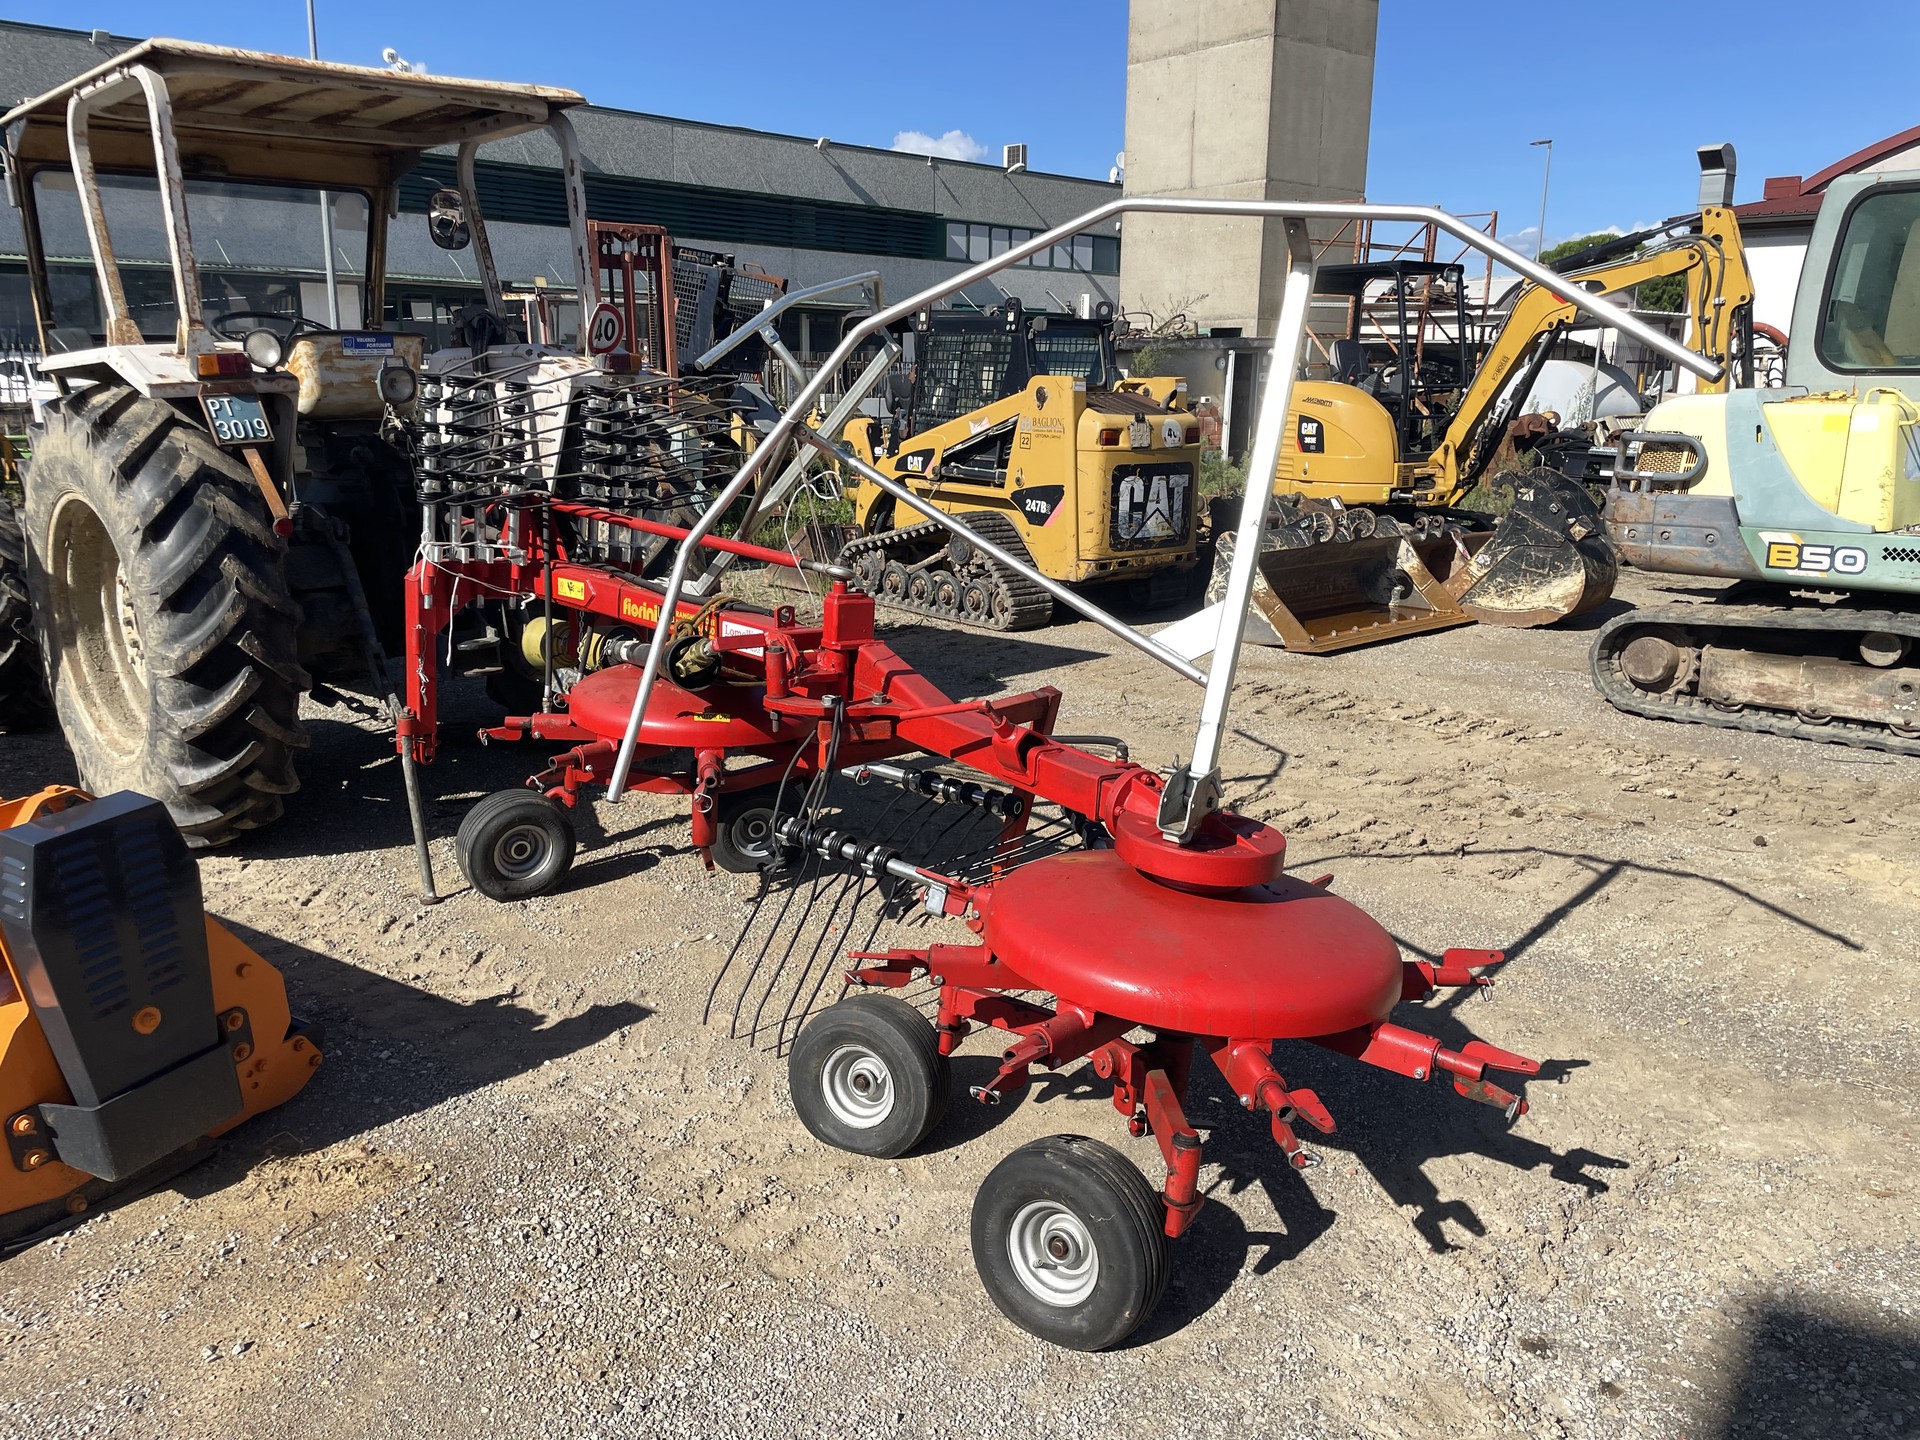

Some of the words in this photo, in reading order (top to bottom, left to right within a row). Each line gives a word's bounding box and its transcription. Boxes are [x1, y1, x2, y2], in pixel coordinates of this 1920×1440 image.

[594, 318, 616, 341] 40
[206, 398, 233, 418] PT
[215, 418, 269, 440] 3019
[1301, 421, 1318, 435] CAT
[1021, 436, 1030, 446] 22
[907, 455, 924, 471] CAT
[1117, 473, 1190, 540] CAT
[1765, 541, 1869, 576] B50
[622, 597, 659, 623] fiorini
